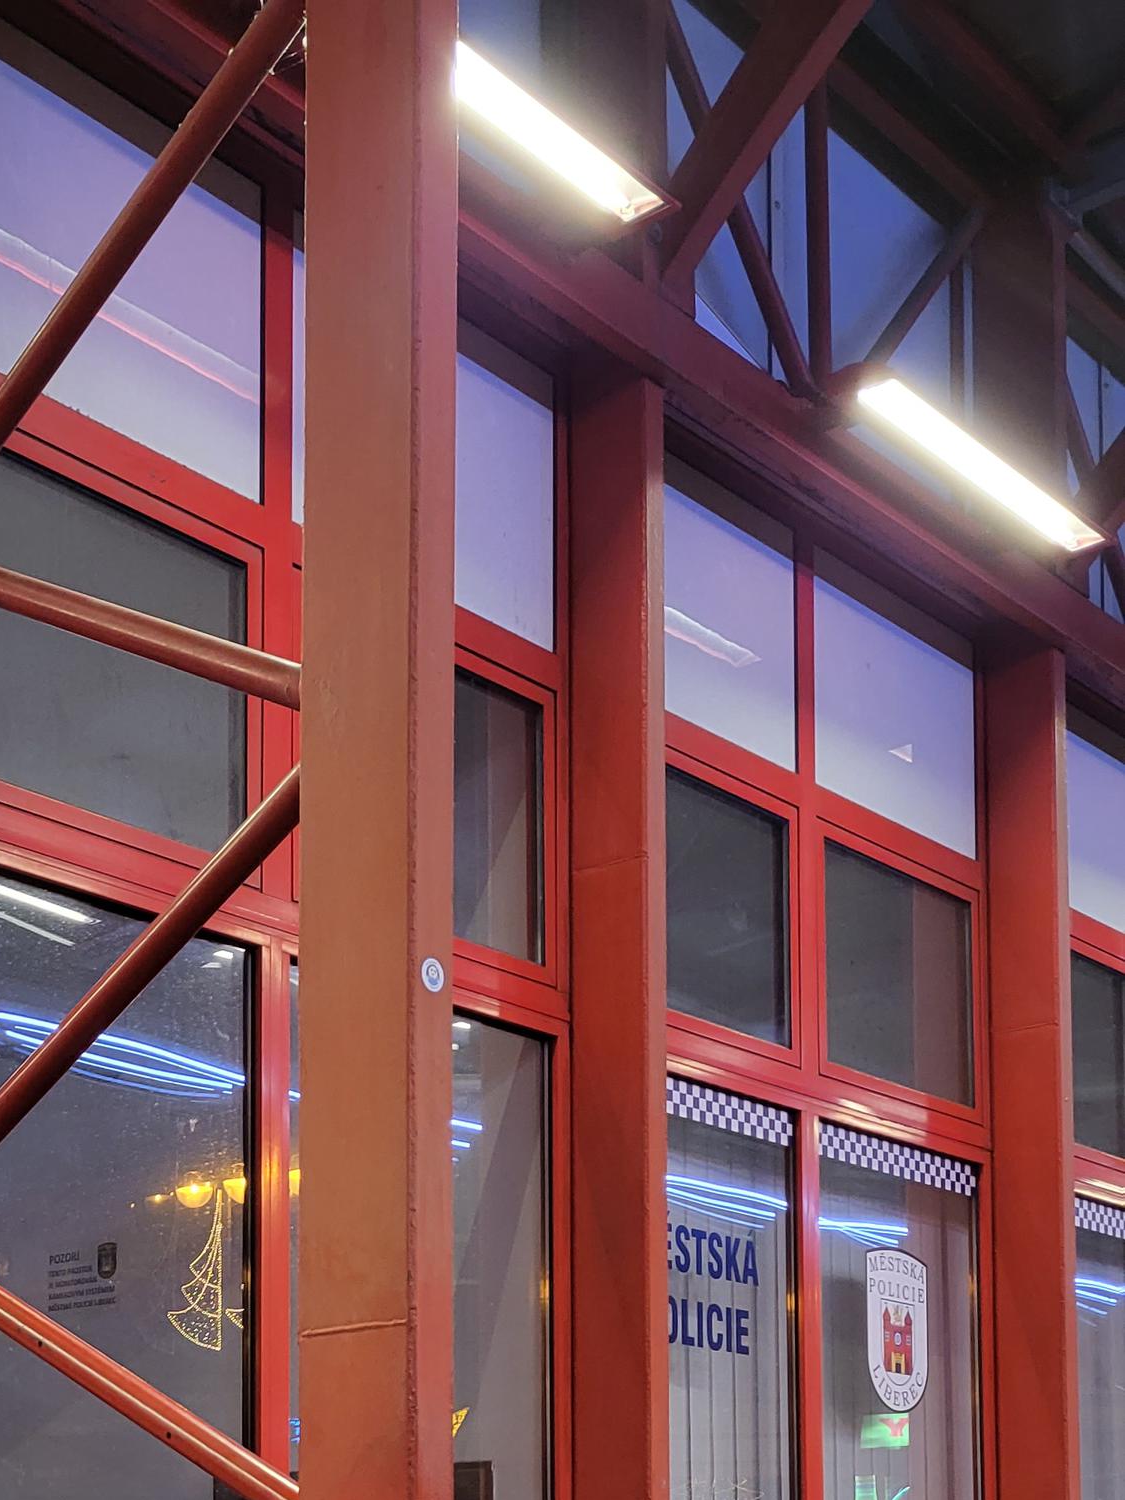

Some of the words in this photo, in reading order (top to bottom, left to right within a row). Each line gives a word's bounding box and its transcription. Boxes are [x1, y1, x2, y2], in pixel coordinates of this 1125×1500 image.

[869, 1253, 925, 1285] MĚSTSKÁ
[869, 1278, 925, 1304] POLICIE
[669, 1296, 750, 1355] OLICIE
[873, 1364, 924, 1407] LIBEREC
